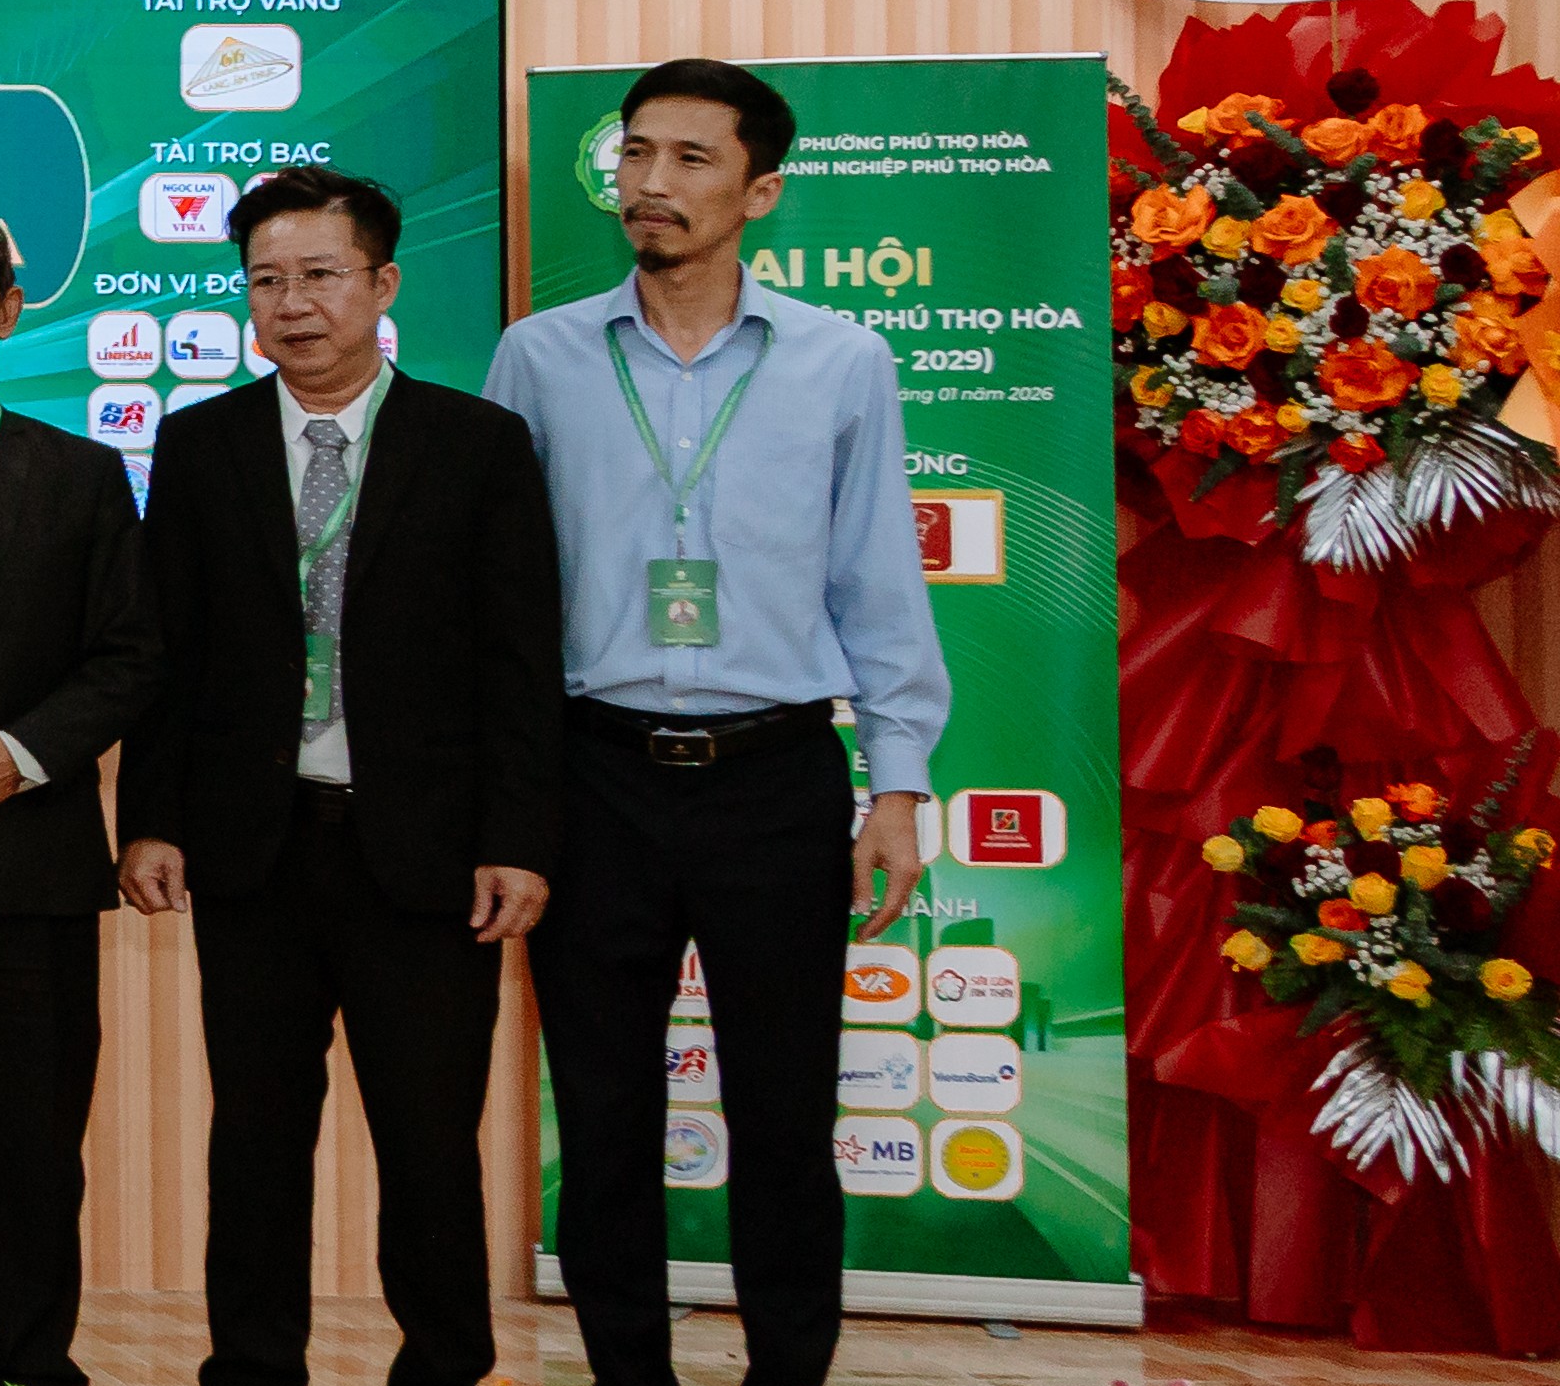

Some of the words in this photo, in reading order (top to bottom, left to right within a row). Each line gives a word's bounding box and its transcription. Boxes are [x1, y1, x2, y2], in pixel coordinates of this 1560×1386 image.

[150, 137, 195, 163] TÀI
[202, 139, 262, 168] TRỢ
[270, 142, 332, 168] BẠC
[799, 132, 885, 151] PHƯỜNG
[889, 131, 933, 151] PHÚ
[935, 134, 979, 152] THỌ
[982, 129, 1029, 149] HÒA
[832, 156, 908, 178] NGHIỆP
[911, 155, 955, 175] PHÚ
[958, 158, 1002, 176] THỌ
[1005, 154, 1053, 173] HÒA
[824, 236, 932, 298] HỘI
[94, 270, 161, 295] ĐƠN
[169, 273, 197, 299] VỊ
[863, 302, 931, 331] PHÚ
[935, 308, 1003, 335] THỌ
[1010, 302, 1083, 329] HÒA
[910, 346, 996, 374] 2029)
[937, 387, 959, 402] 01
[960, 386, 1005, 402] năm
[1007, 386, 1055, 402] 2026
[872, 1140, 916, 1162] MB
